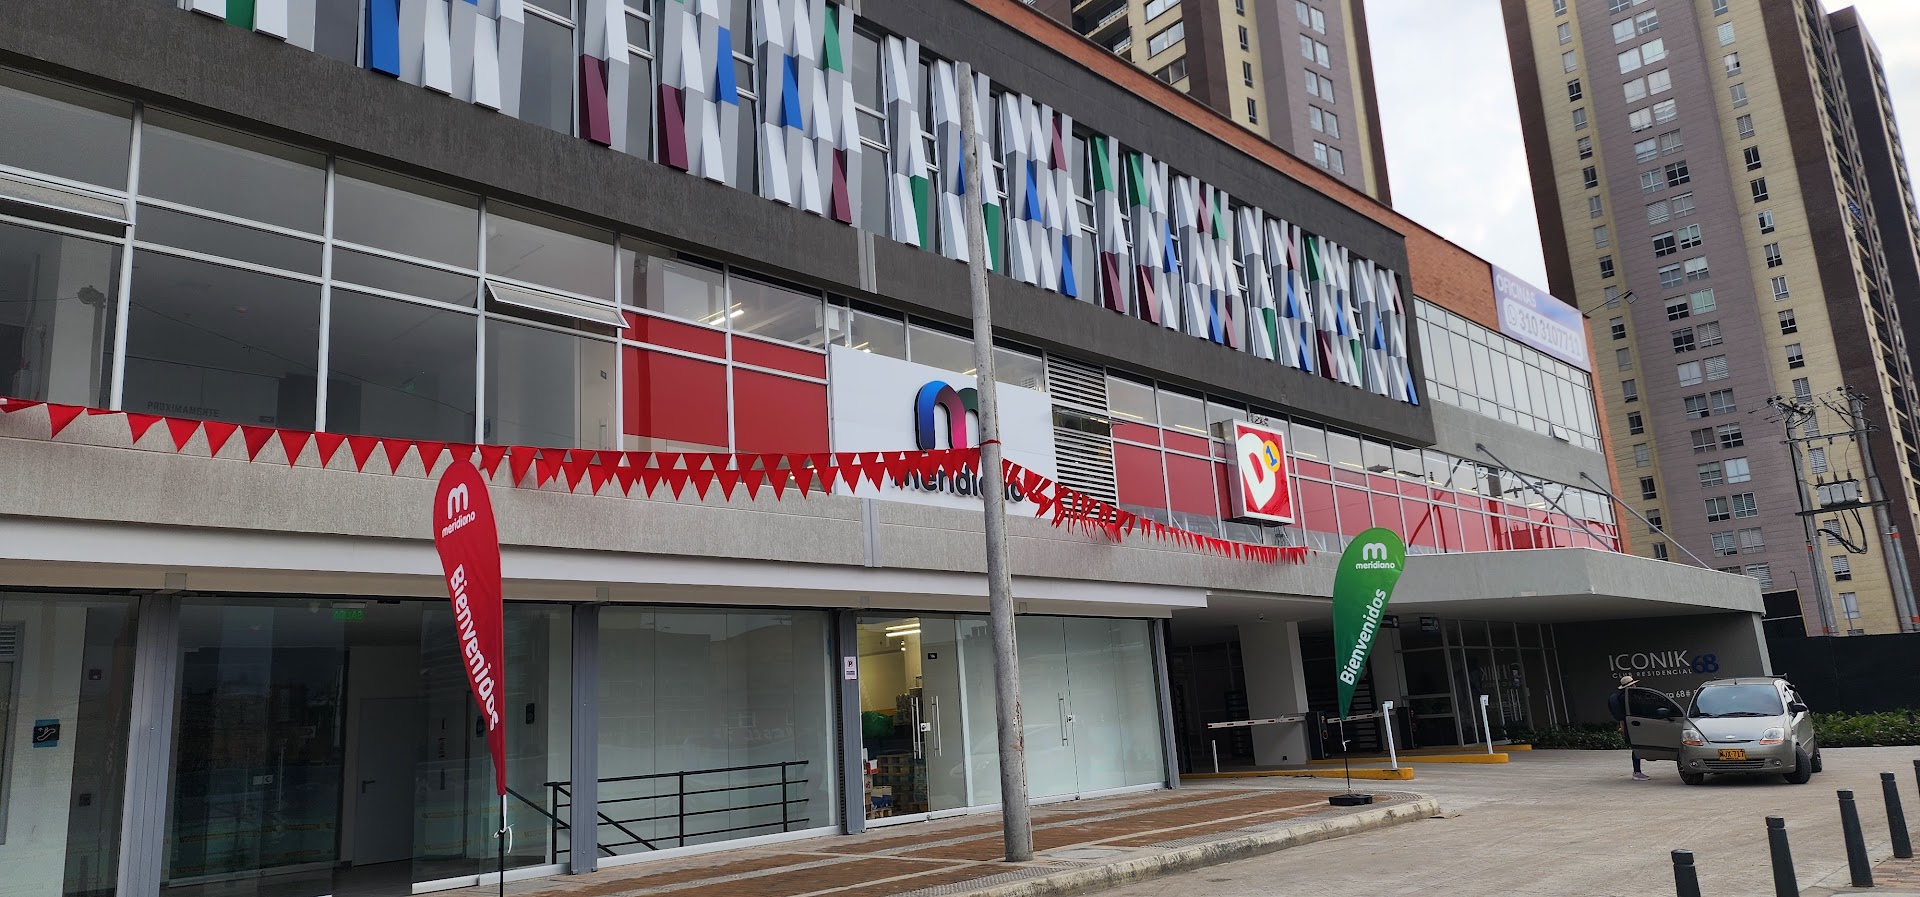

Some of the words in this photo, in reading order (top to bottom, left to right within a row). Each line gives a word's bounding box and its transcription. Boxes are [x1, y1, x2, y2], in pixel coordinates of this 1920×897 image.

[1495, 273, 1537, 308] OFICINAS
[1518, 309, 1539, 337] 310
[441, 510, 476, 538] meridiano
[1355, 560, 1396, 570] meridiano
[450, 563, 499, 732] Bienvenidos
[1339, 588, 1387, 686] Bienvenidos
[1608, 649, 1691, 671] ICONIK
[1692, 653, 1719, 674] 68
[1636, 668, 1693, 678] RESIDENCIAL
[1675, 689, 1685, 698] 68
